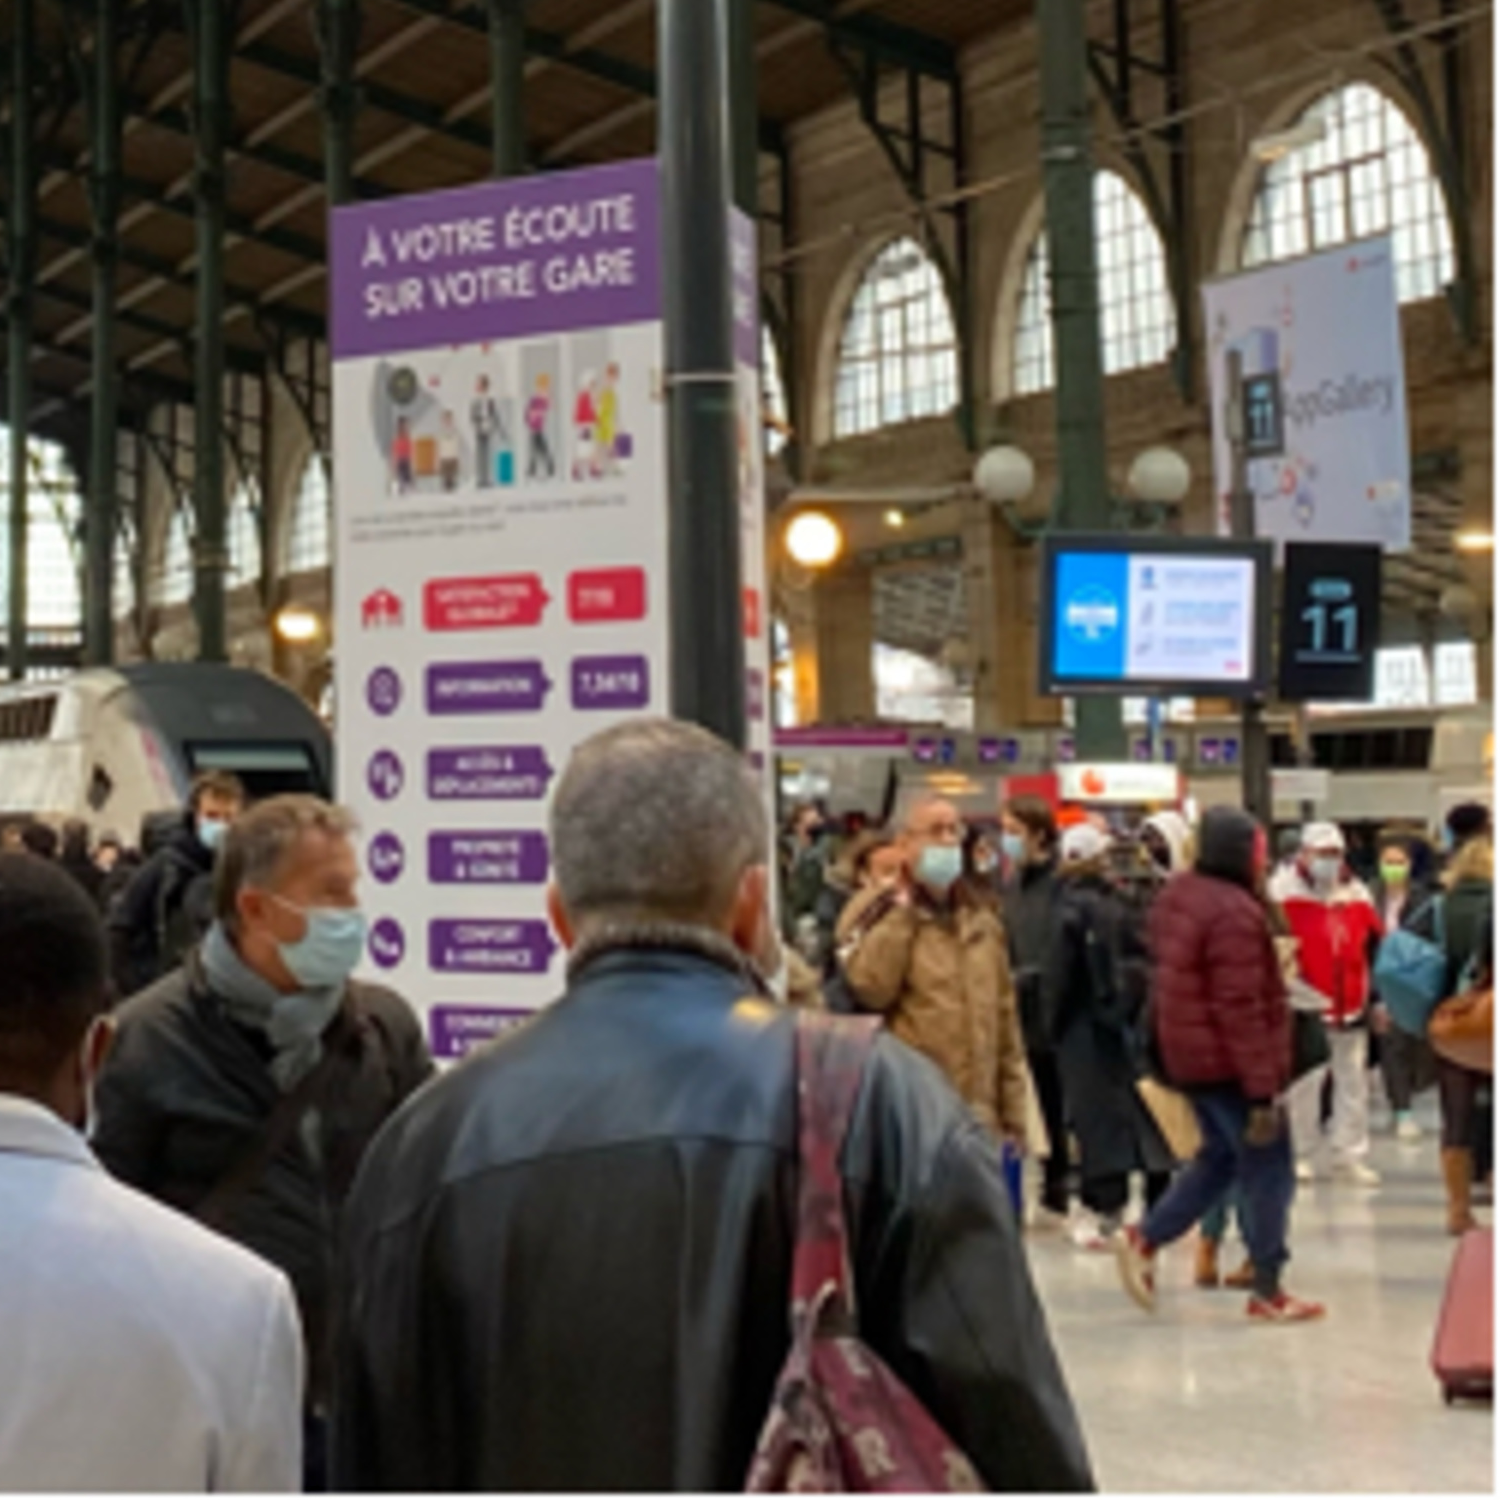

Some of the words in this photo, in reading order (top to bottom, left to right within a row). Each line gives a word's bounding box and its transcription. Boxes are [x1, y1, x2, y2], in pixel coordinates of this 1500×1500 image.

[362, 224, 386, 269] À
[392, 217, 496, 262] VOTRE
[504, 194, 636, 250] ÉCOUTE
[364, 280, 423, 319] SUR
[432, 261, 537, 308] VOTRE
[544, 248, 635, 293] GARE
[1301, 604, 1358, 652] 11
